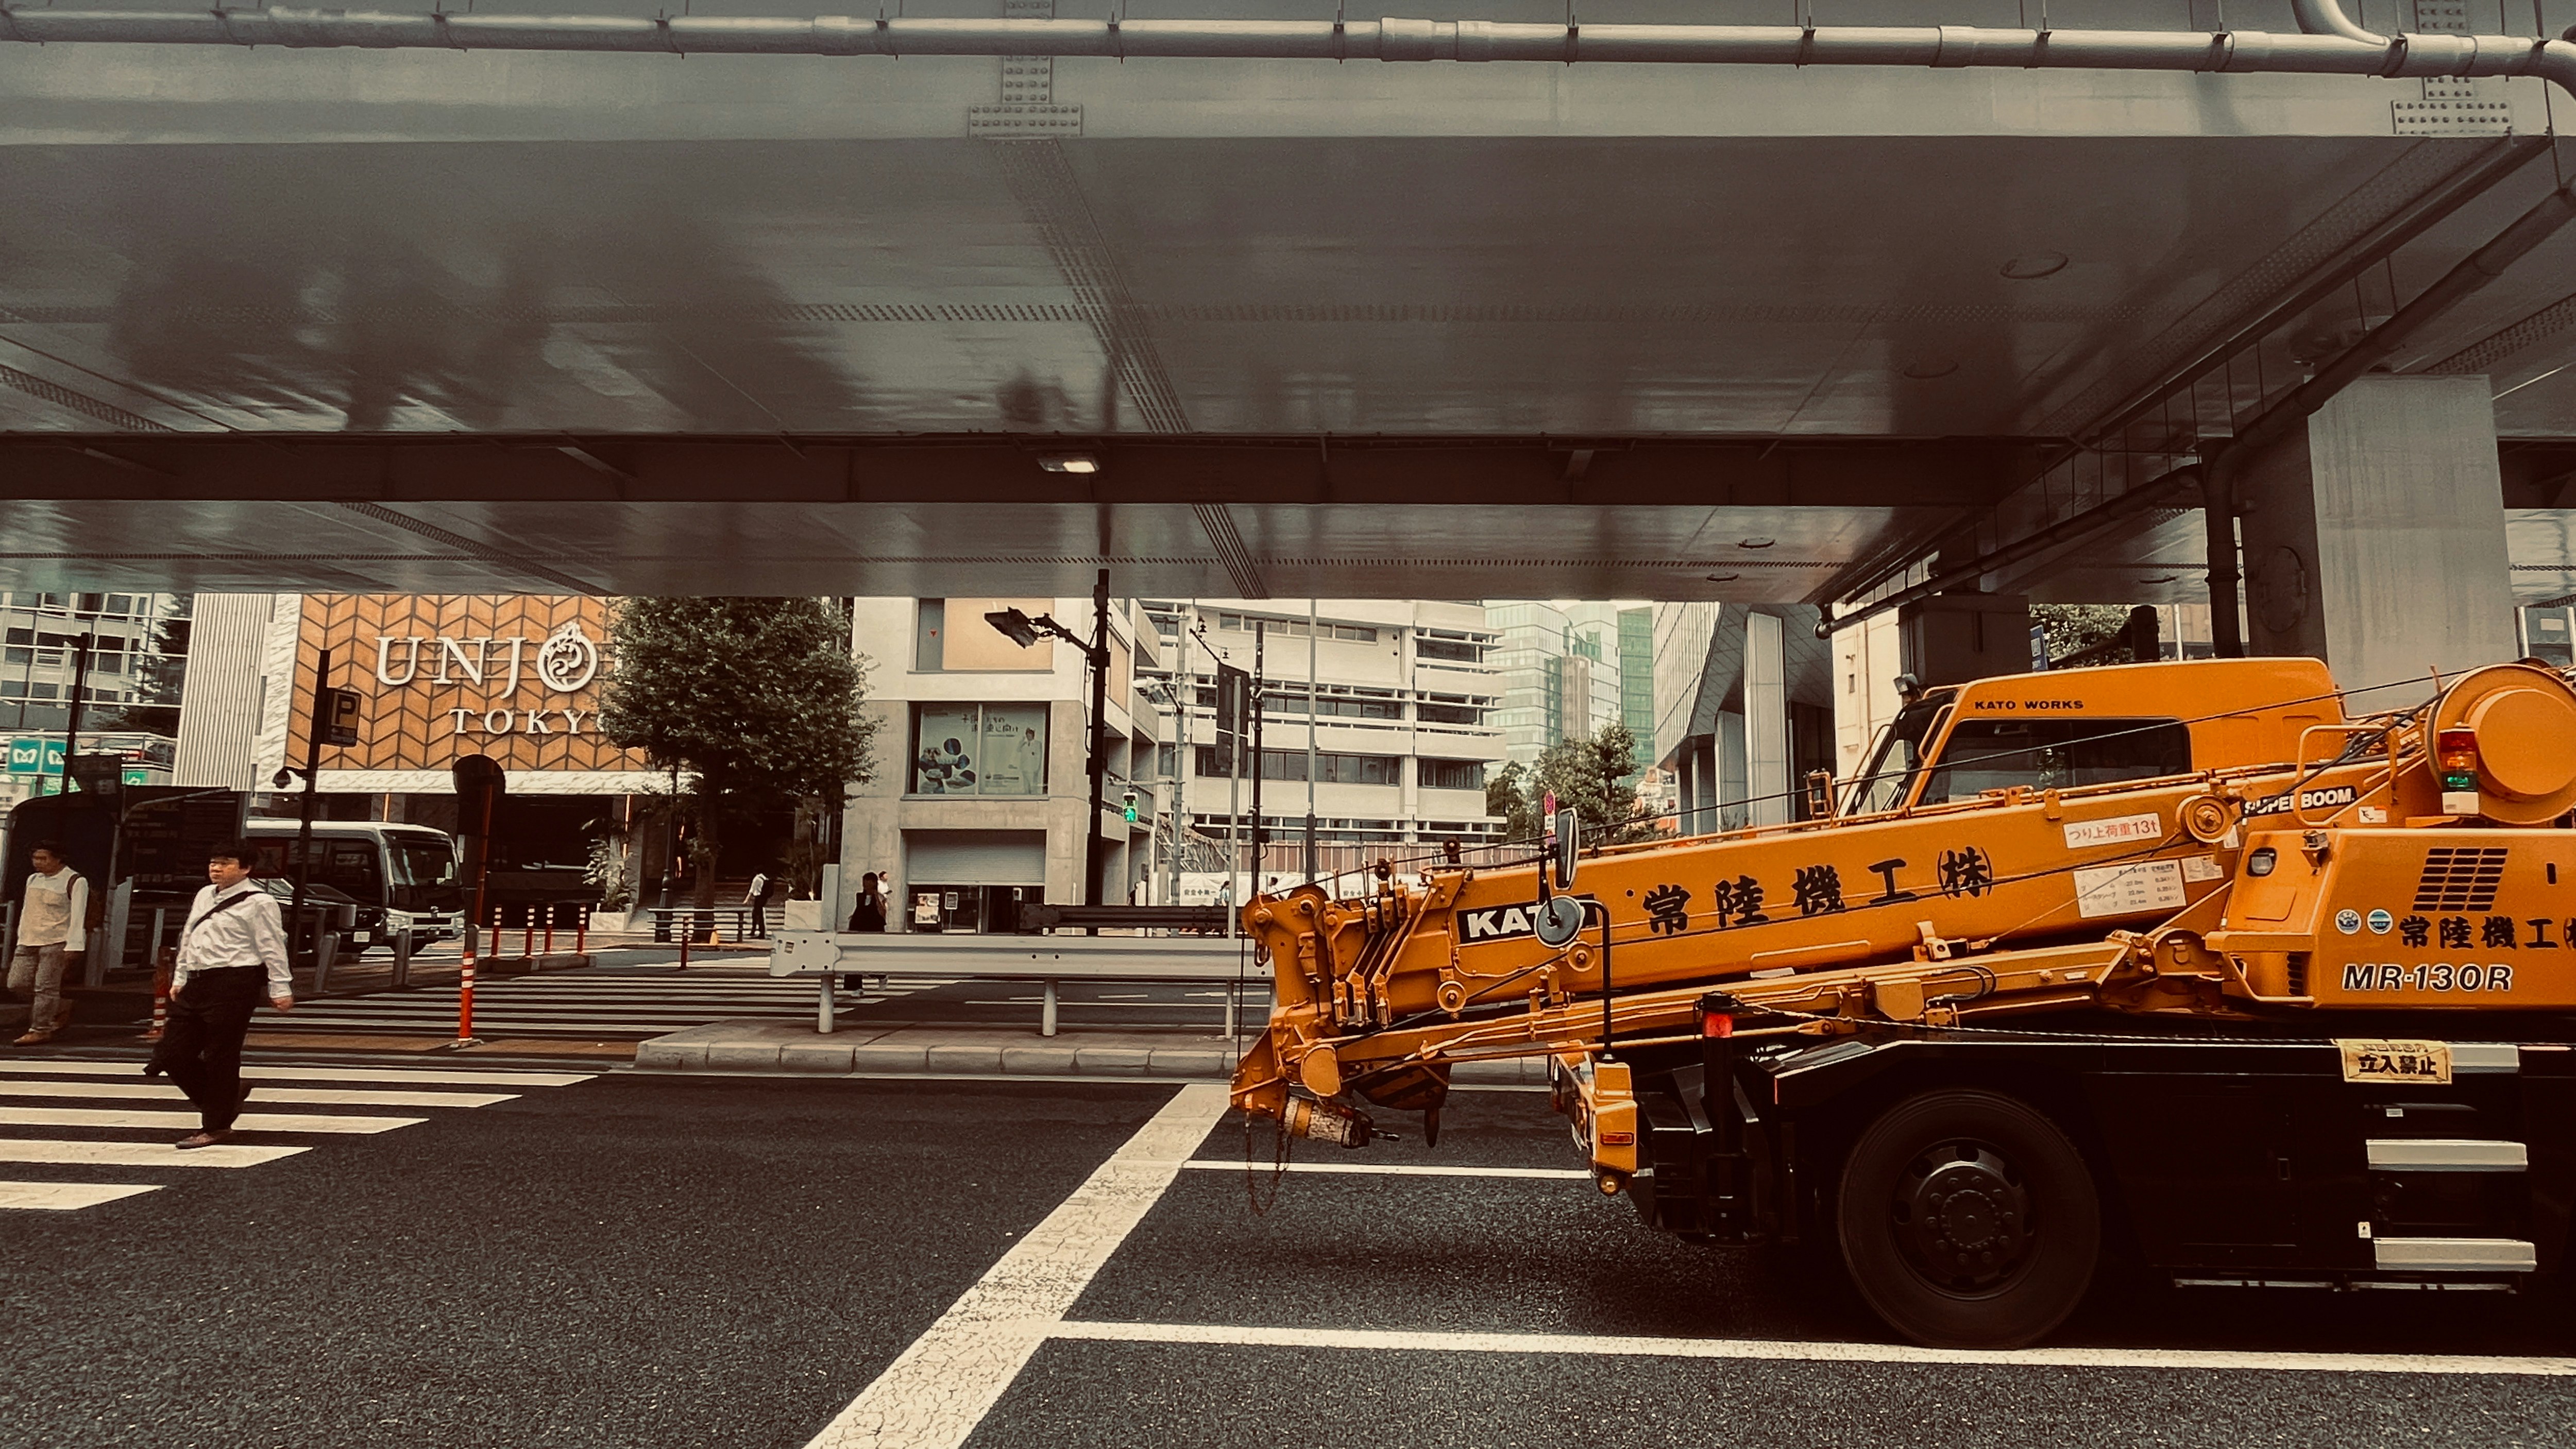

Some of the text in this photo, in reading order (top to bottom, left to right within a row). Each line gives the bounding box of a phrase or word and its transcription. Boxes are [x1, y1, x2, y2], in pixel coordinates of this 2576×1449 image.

[375, 621, 623, 699] UNJO
[335, 693, 357, 725] P
[1975, 701, 2084, 710] KATO WORKS
[449, 708, 605, 735] TOKY
[2069, 820, 2158, 840] つり上荷重13t
[2342, 963, 2514, 992] MR-130R
[2358, 1054, 2437, 1075] 立入禁止
